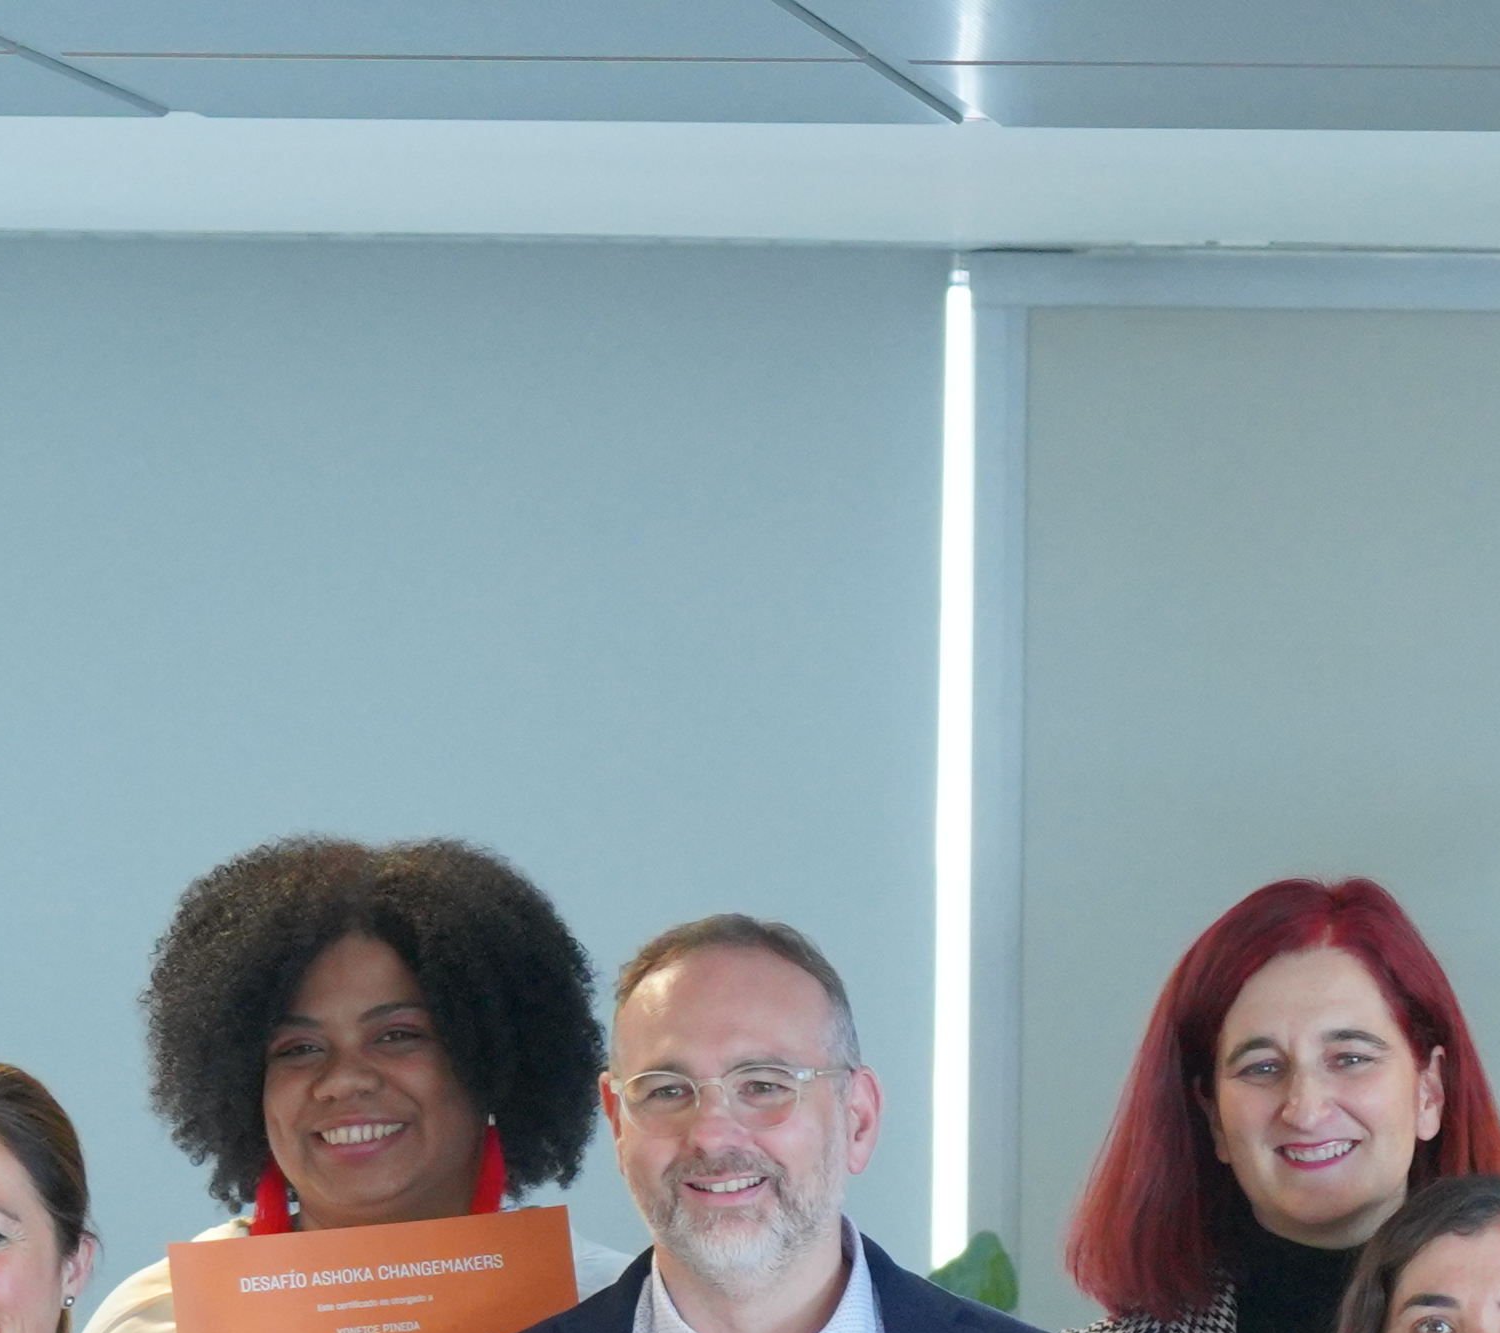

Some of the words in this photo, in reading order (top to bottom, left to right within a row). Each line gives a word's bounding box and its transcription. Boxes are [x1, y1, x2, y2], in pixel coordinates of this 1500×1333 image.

[239, 1269, 307, 1293] DESAFÍO
[312, 1266, 374, 1286] ASHOKA
[377, 1253, 504, 1281] CHANGEMAKERS
[316, 1303, 335, 1312] Este
[335, 1299, 379, 1311] certificado
[390, 1295, 427, 1306] otorgado
